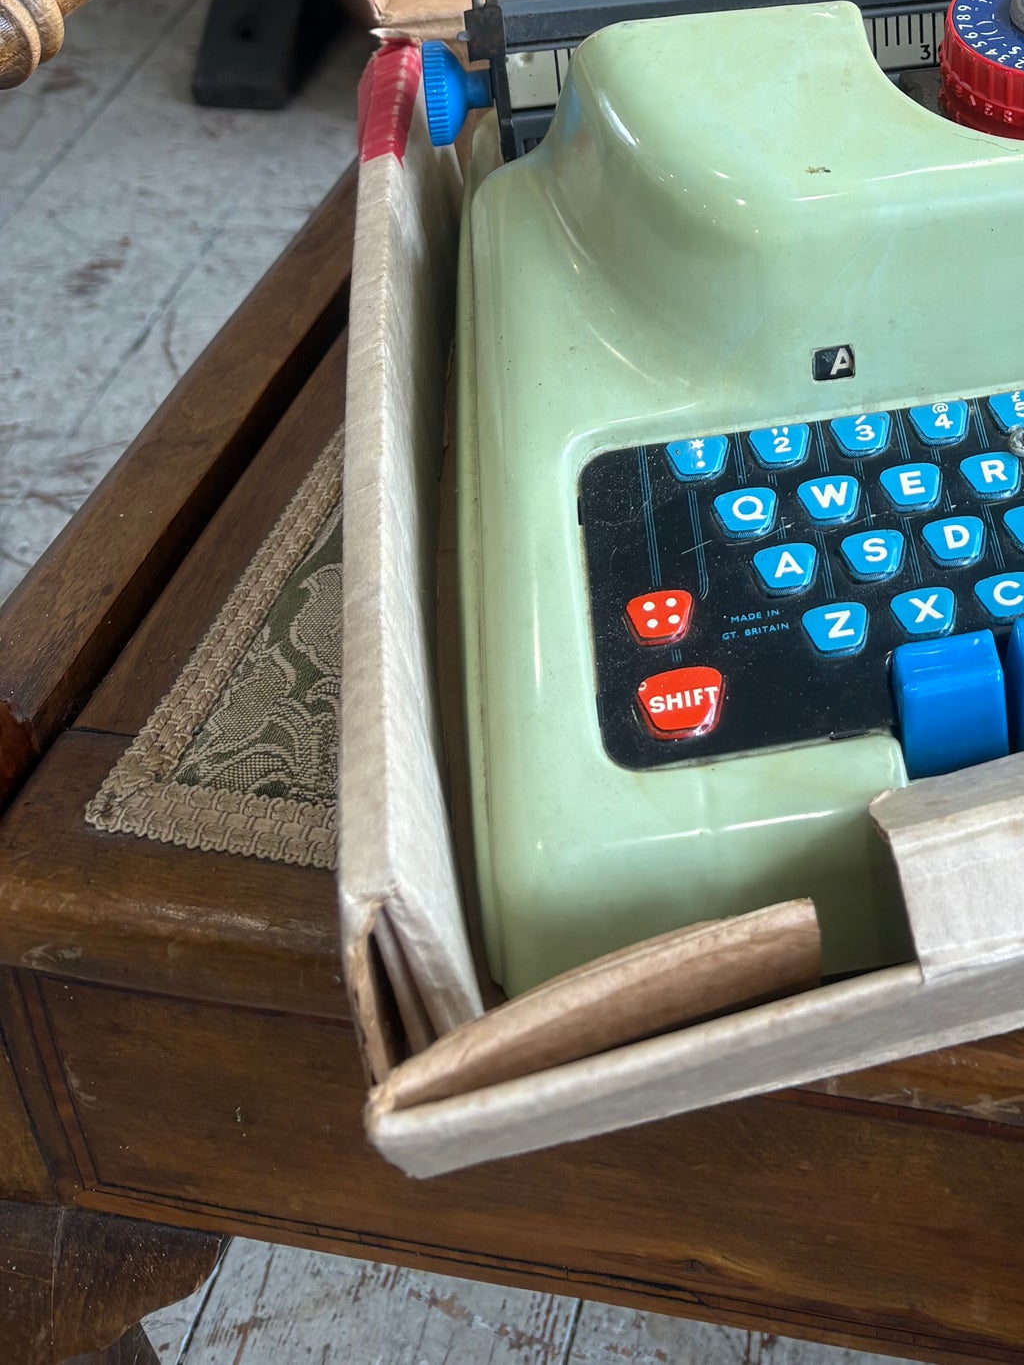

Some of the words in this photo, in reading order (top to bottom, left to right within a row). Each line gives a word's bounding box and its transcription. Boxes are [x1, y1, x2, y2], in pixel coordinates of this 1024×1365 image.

[830, 346, 854, 376] A
[773, 436, 792, 453] 2
[855, 424, 876, 441] 3
[934, 413, 954, 429] 4
[732, 495, 765, 521] Q
[810, 481, 848, 509] W
[899, 470, 926, 496] E
[981, 459, 1006, 483] R
[774, 551, 804, 578] A
[862, 537, 888, 562] S
[943, 524, 970, 550] D
[730, 611, 762, 623] MADE
[767, 608, 780, 618] IN
[824, 610, 855, 639] Z
[912, 594, 944, 623] X
[993, 580, 1024, 606] C
[744, 622, 790, 637] BRITAIN
[648, 686, 720, 714] SHIFT
